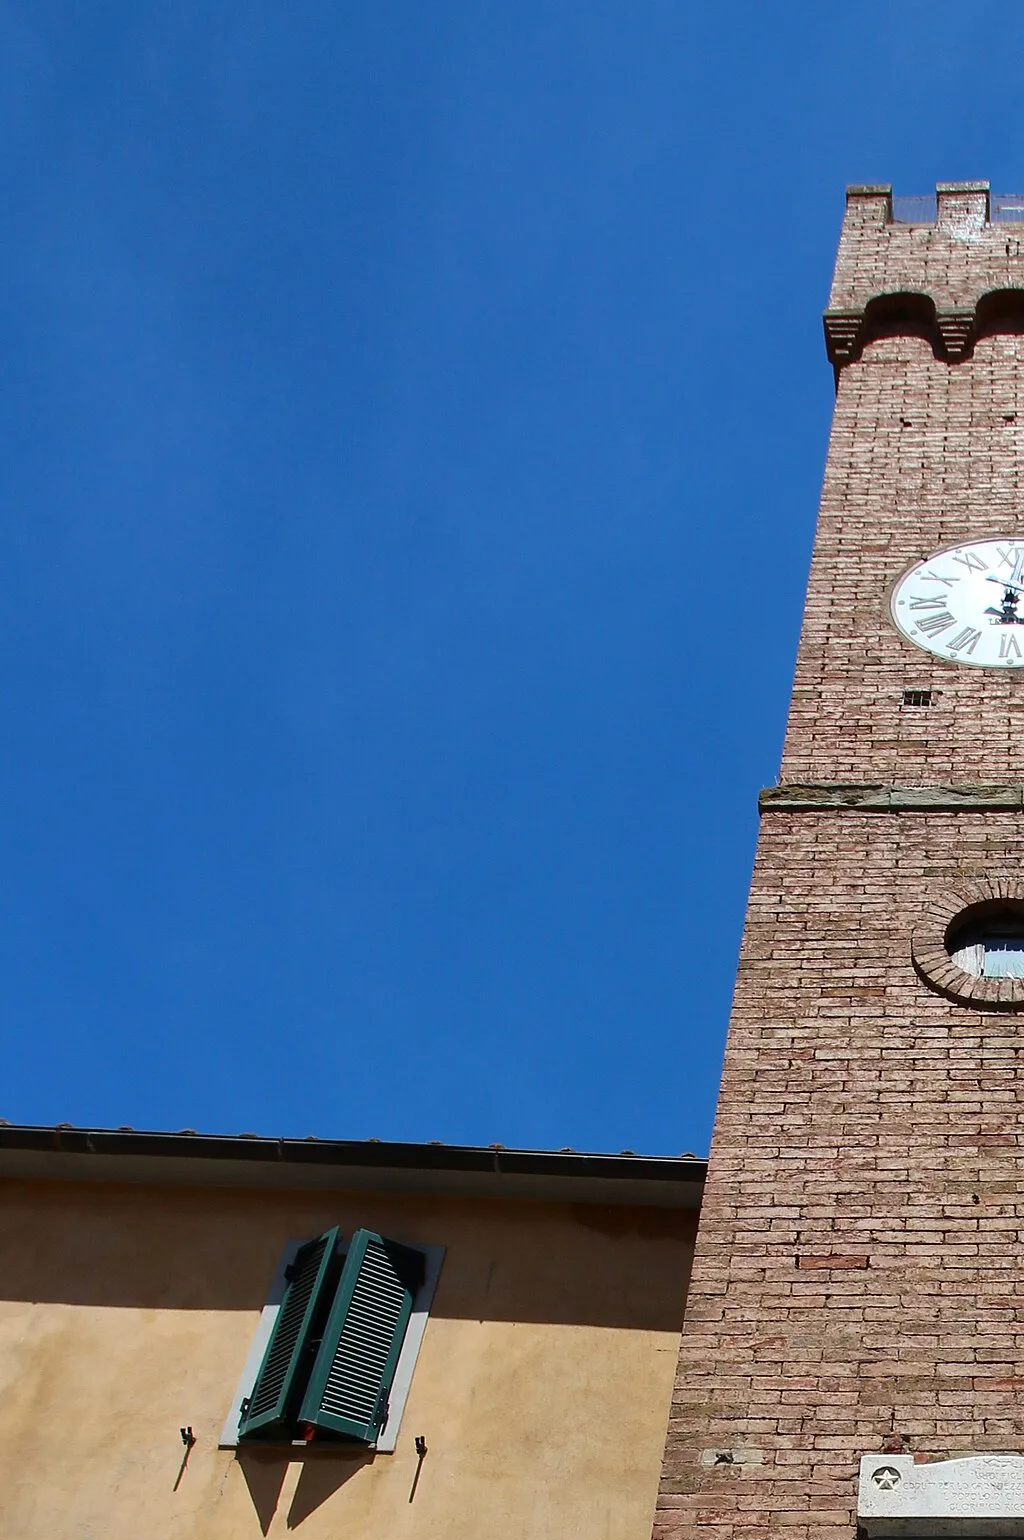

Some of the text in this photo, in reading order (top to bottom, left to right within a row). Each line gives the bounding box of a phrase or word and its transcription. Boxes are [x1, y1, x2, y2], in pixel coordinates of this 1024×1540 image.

[952, 552, 989, 574] XI
[920, 571, 960, 587] X
[914, 611, 957, 638] VIII
[945, 627, 982, 655] VII
[999, 633, 1022, 657] VI
